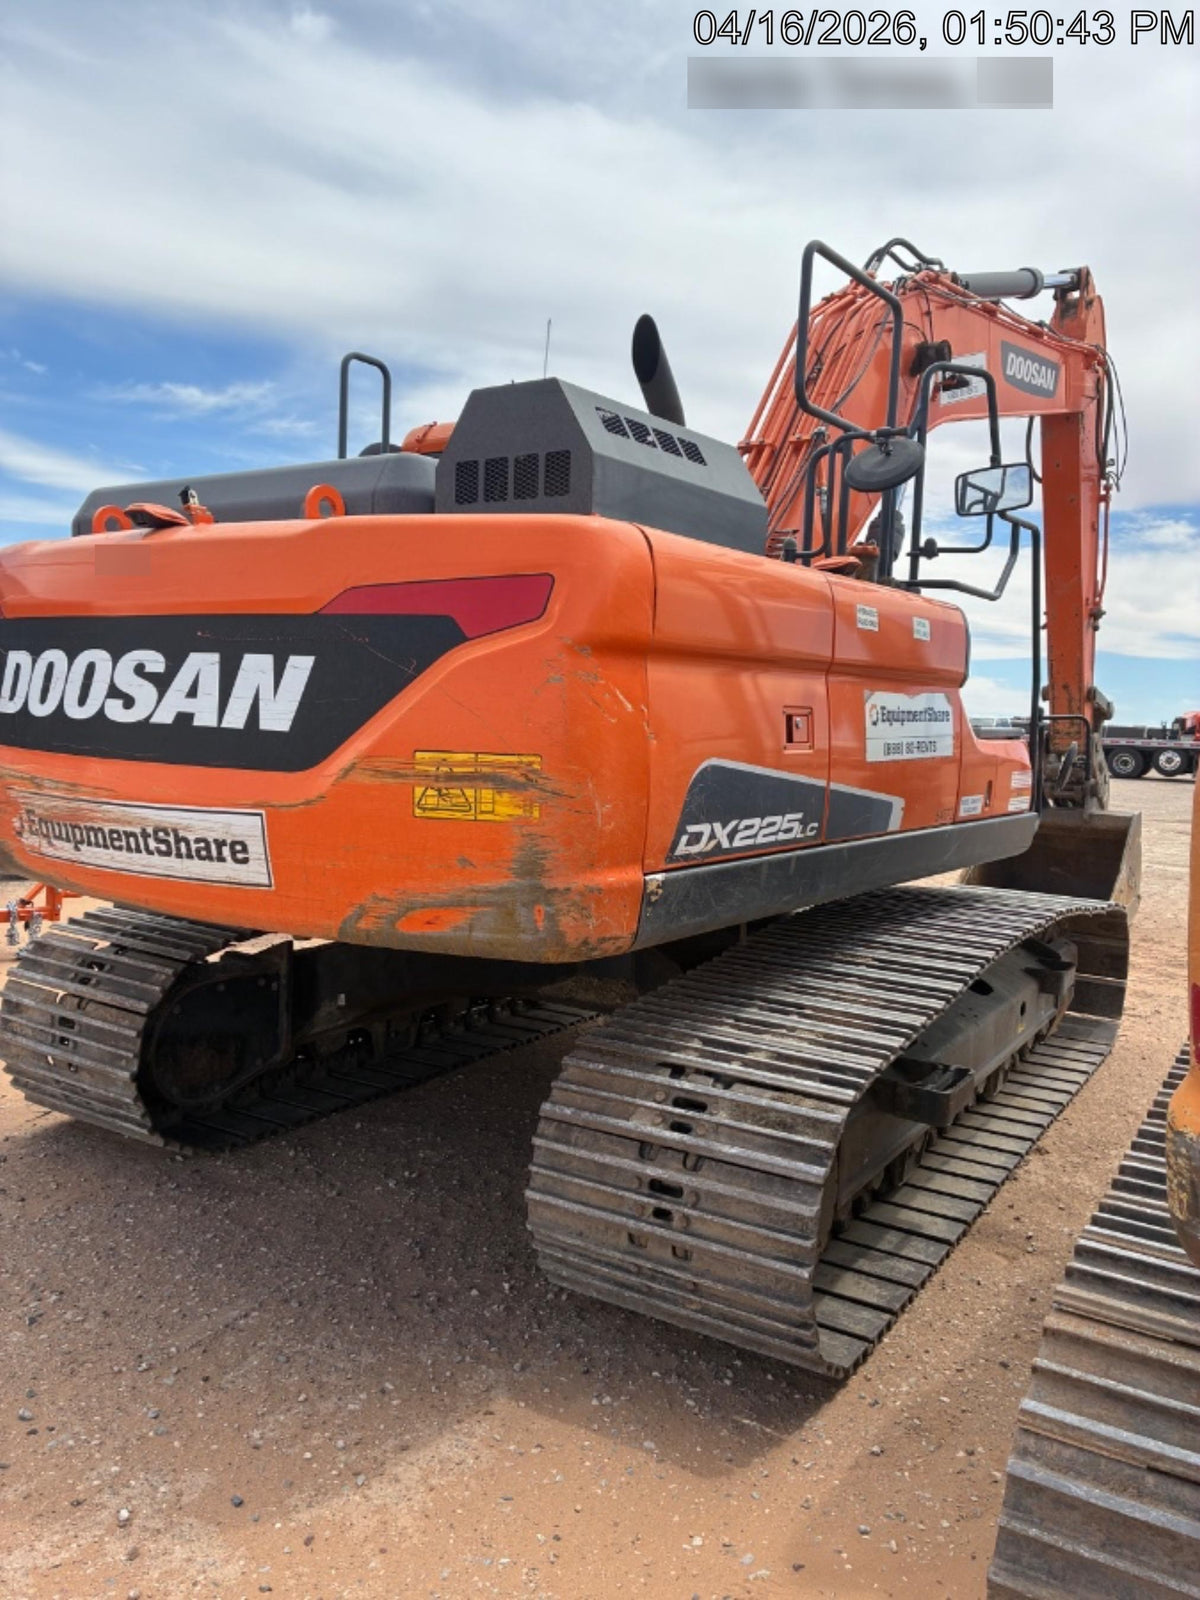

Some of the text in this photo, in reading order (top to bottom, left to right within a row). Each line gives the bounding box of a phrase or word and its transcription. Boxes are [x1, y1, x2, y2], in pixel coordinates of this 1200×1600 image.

[1006, 352, 1055, 391] DOOSAN
[0, 648, 316, 732] DOOSAN
[880, 705, 950, 726] EquipmentShare
[25, 808, 250, 865] EquipmentShare
